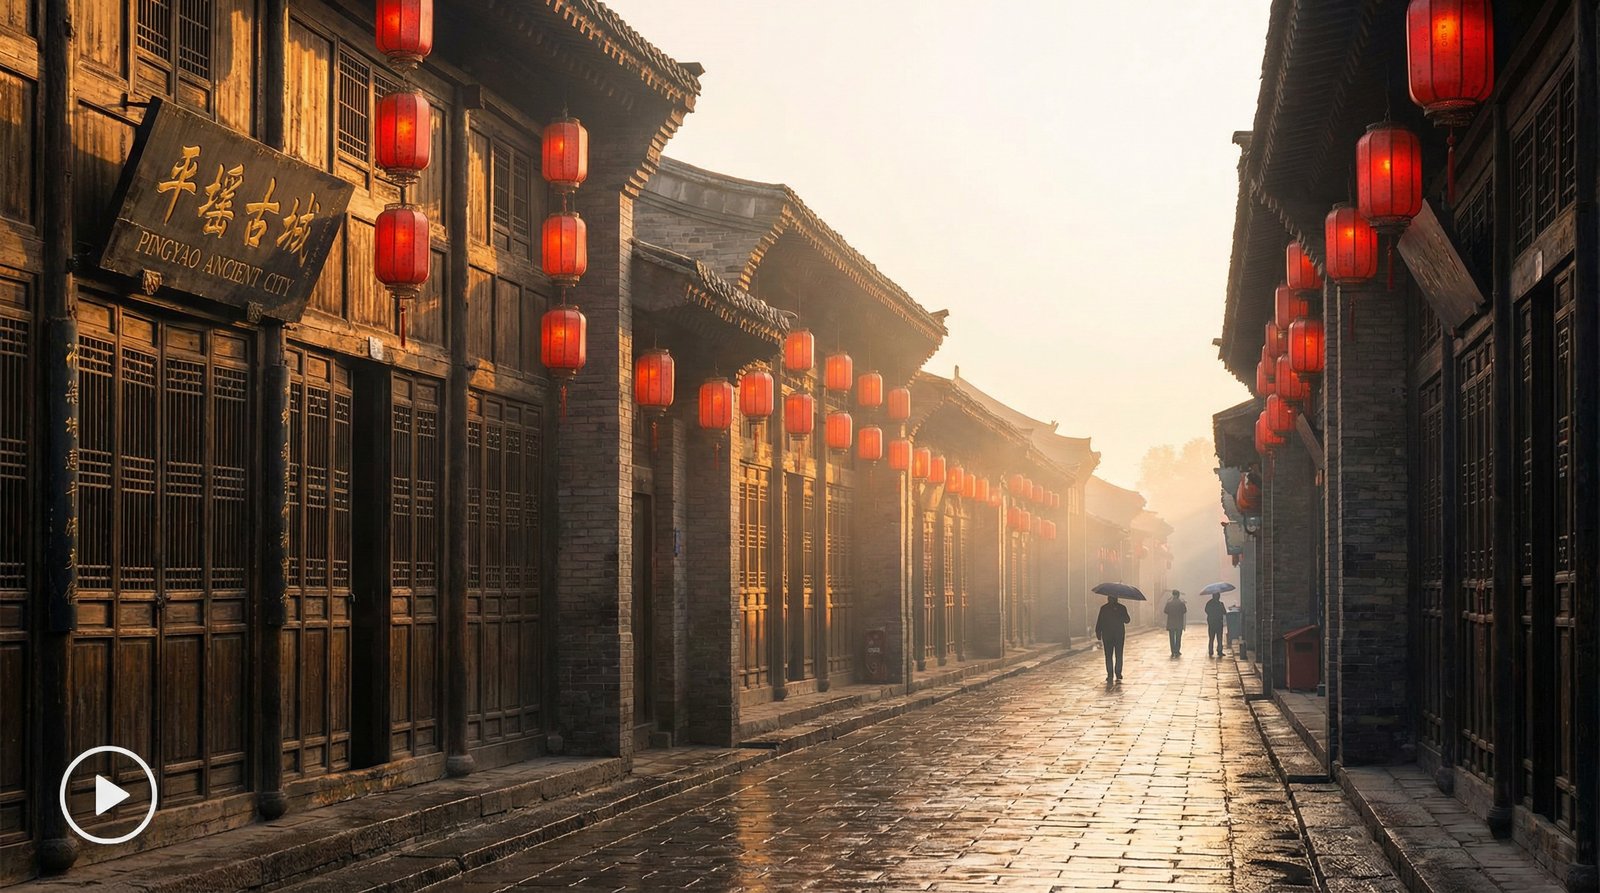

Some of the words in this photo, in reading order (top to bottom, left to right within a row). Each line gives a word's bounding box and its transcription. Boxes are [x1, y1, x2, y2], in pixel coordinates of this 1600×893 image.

[135, 231, 201, 269] PINGYAO
[203, 254, 263, 289] ANCIENT
[263, 272, 295, 297] CITY
